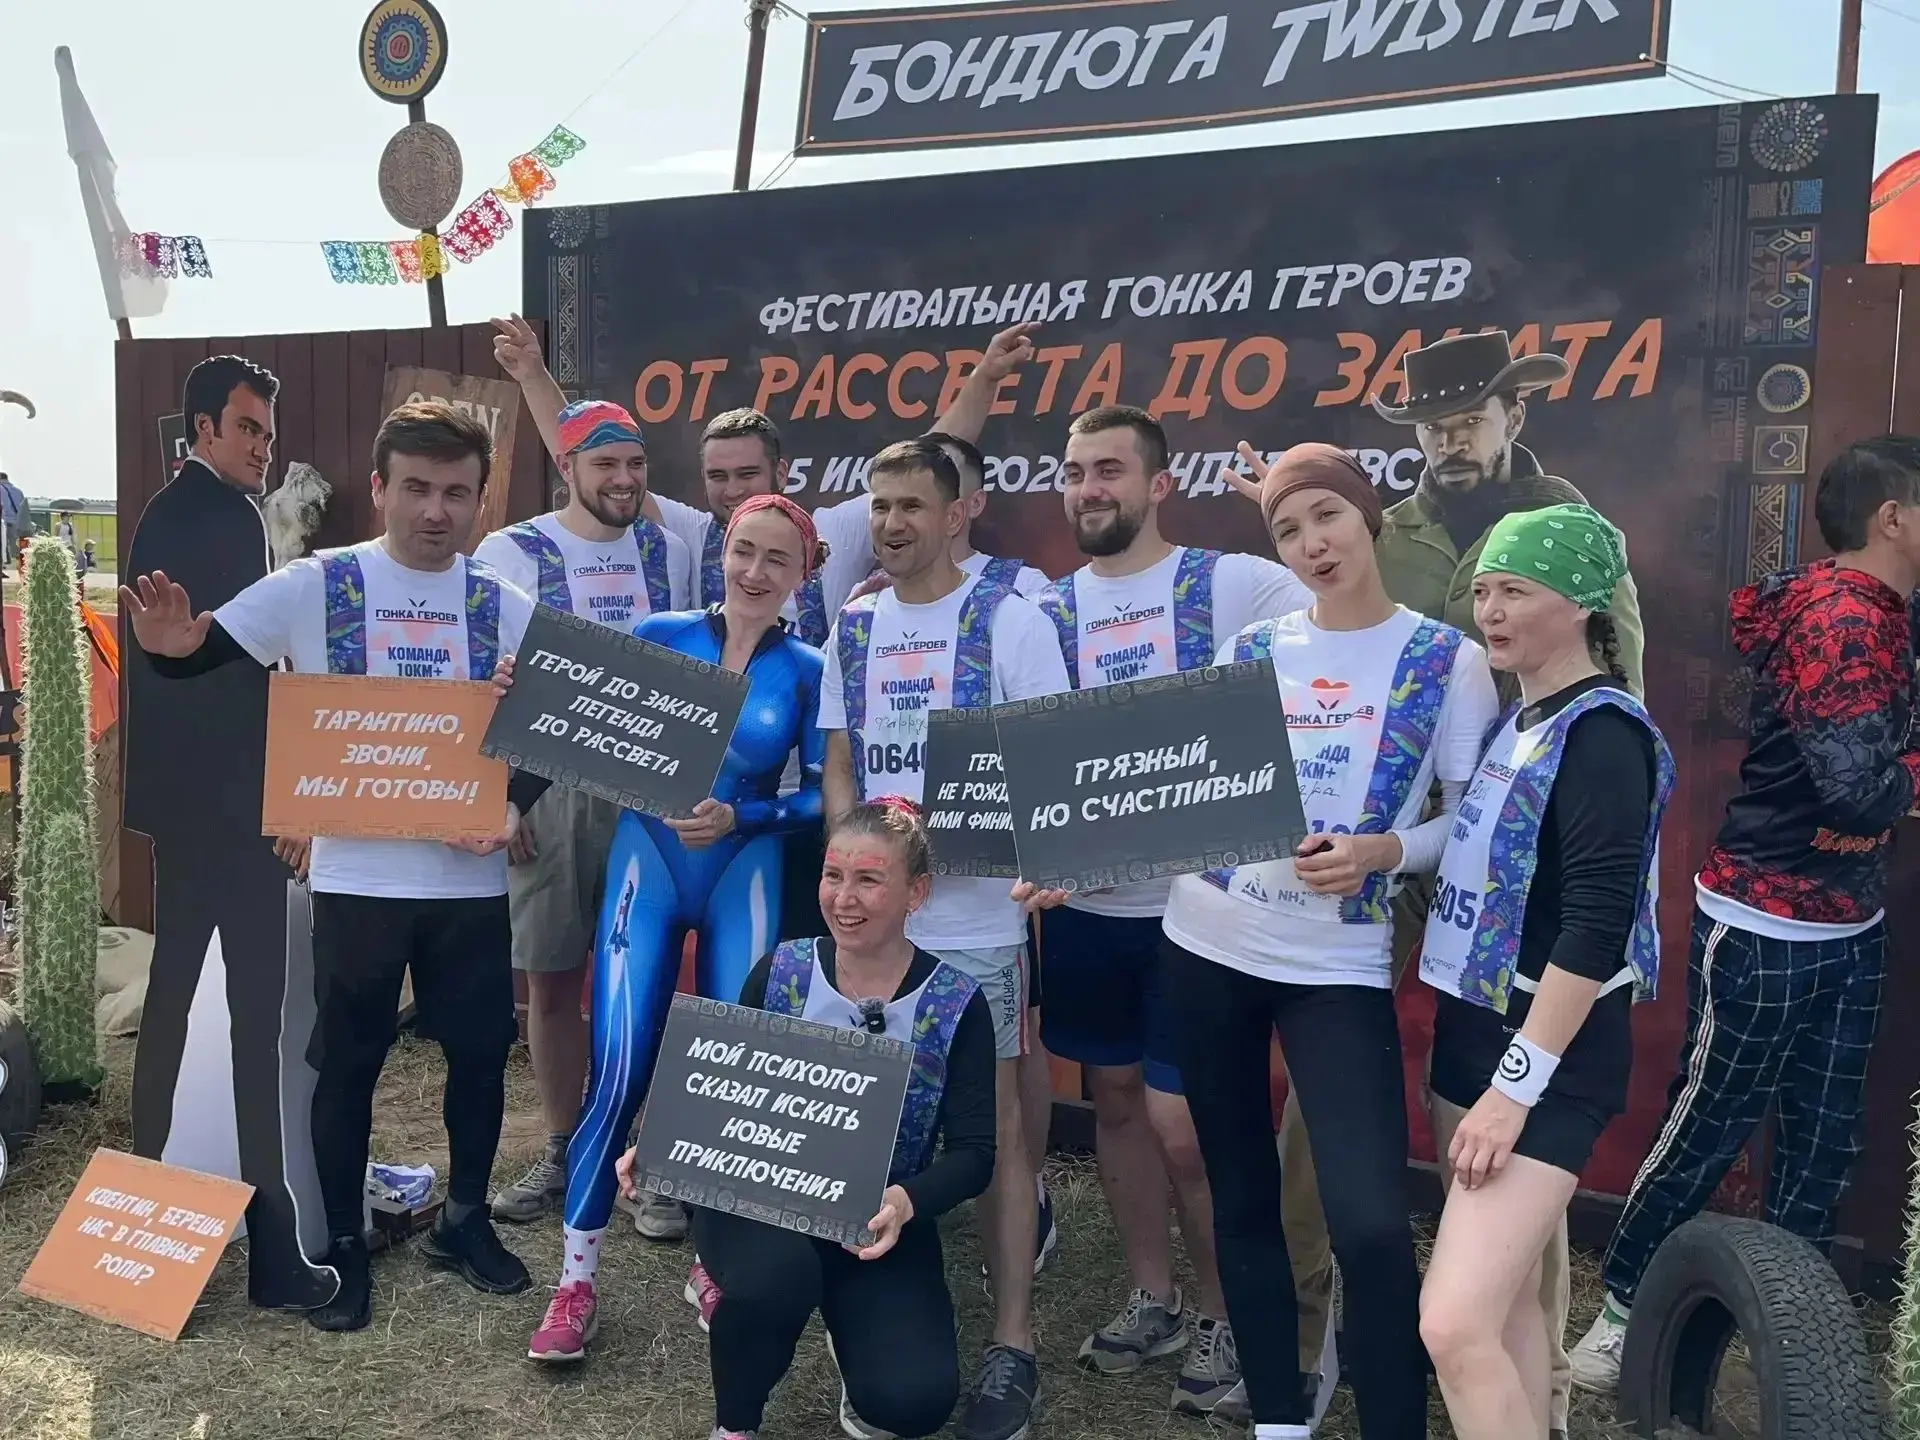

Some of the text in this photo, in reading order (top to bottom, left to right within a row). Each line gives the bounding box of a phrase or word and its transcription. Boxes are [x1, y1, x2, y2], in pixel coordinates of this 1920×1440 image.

[833, 17, 1227, 121] БОНДЮГА
[759, 257, 1472, 335] ФЕСТИВАЛЬНАЯ ГОНКА ГЕРОЕВ
[635, 358, 729, 424] ОТ
[1149, 336, 1288, 420] ДО
[1313, 318, 1662, 408] ЗААТА
[819, 456, 872, 493] ИЮ
[573, 563, 636, 576] ГОНКА ГЕРОЕВ
[376, 609, 458, 622] ГОНКА ГЕРОЕВ
[588, 595, 635, 609] КОМАНДА
[1085, 605, 1165, 632] ГОНКА ГЕРОЕВ
[387, 647, 451, 664] КОМАНДА
[876, 640, 947, 655] ГОНКА ГЕРОЕВ
[1095, 642, 1155, 669] КОМАНДА
[528, 649, 721, 736] ГЕРОЙ ДО ЗАКАТА.
[881, 677, 935, 695] КОМАНДА
[313, 708, 466, 744] ТАРАНТИНО,
[567, 695, 667, 742] ЛЕГЕНДА
[1285, 704, 1375, 725] ОНКА ГЕРЕВ
[341, 743, 432, 772] ЗВОНИ.
[529, 712, 681, 778] ДО РАССВЕТА
[867, 741, 927, 775] 064
[1073, 735, 1218, 786] ГРЯЗНЫЙ,
[294, 775, 480, 806] МЫ ГОТОВЫ!
[937, 782, 1010, 804] НЕ РОЖД
[1029, 762, 1277, 832] НО СЧАСТЛИВЫЙ
[927, 810, 1015, 831] ИМИ ФИНИ
[1003, 968, 1015, 1006] SPORTS
[686, 1037, 878, 1096] МОЙ ПСИХОЛОГ
[685, 1072, 860, 1131] СКАЗАЛ ИСКАТЬ
[720, 1117, 807, 1155] НОВЫЕ
[668, 1139, 846, 1203] ПРИКЛЮЧЕНИЯ
[85, 1186, 226, 1237] КВЕНТИН, БЕРЕШЬ
[77, 1215, 206, 1264] НАС В ГЛАВНЫЕ
[94, 1252, 155, 1286] РОЛИ?
